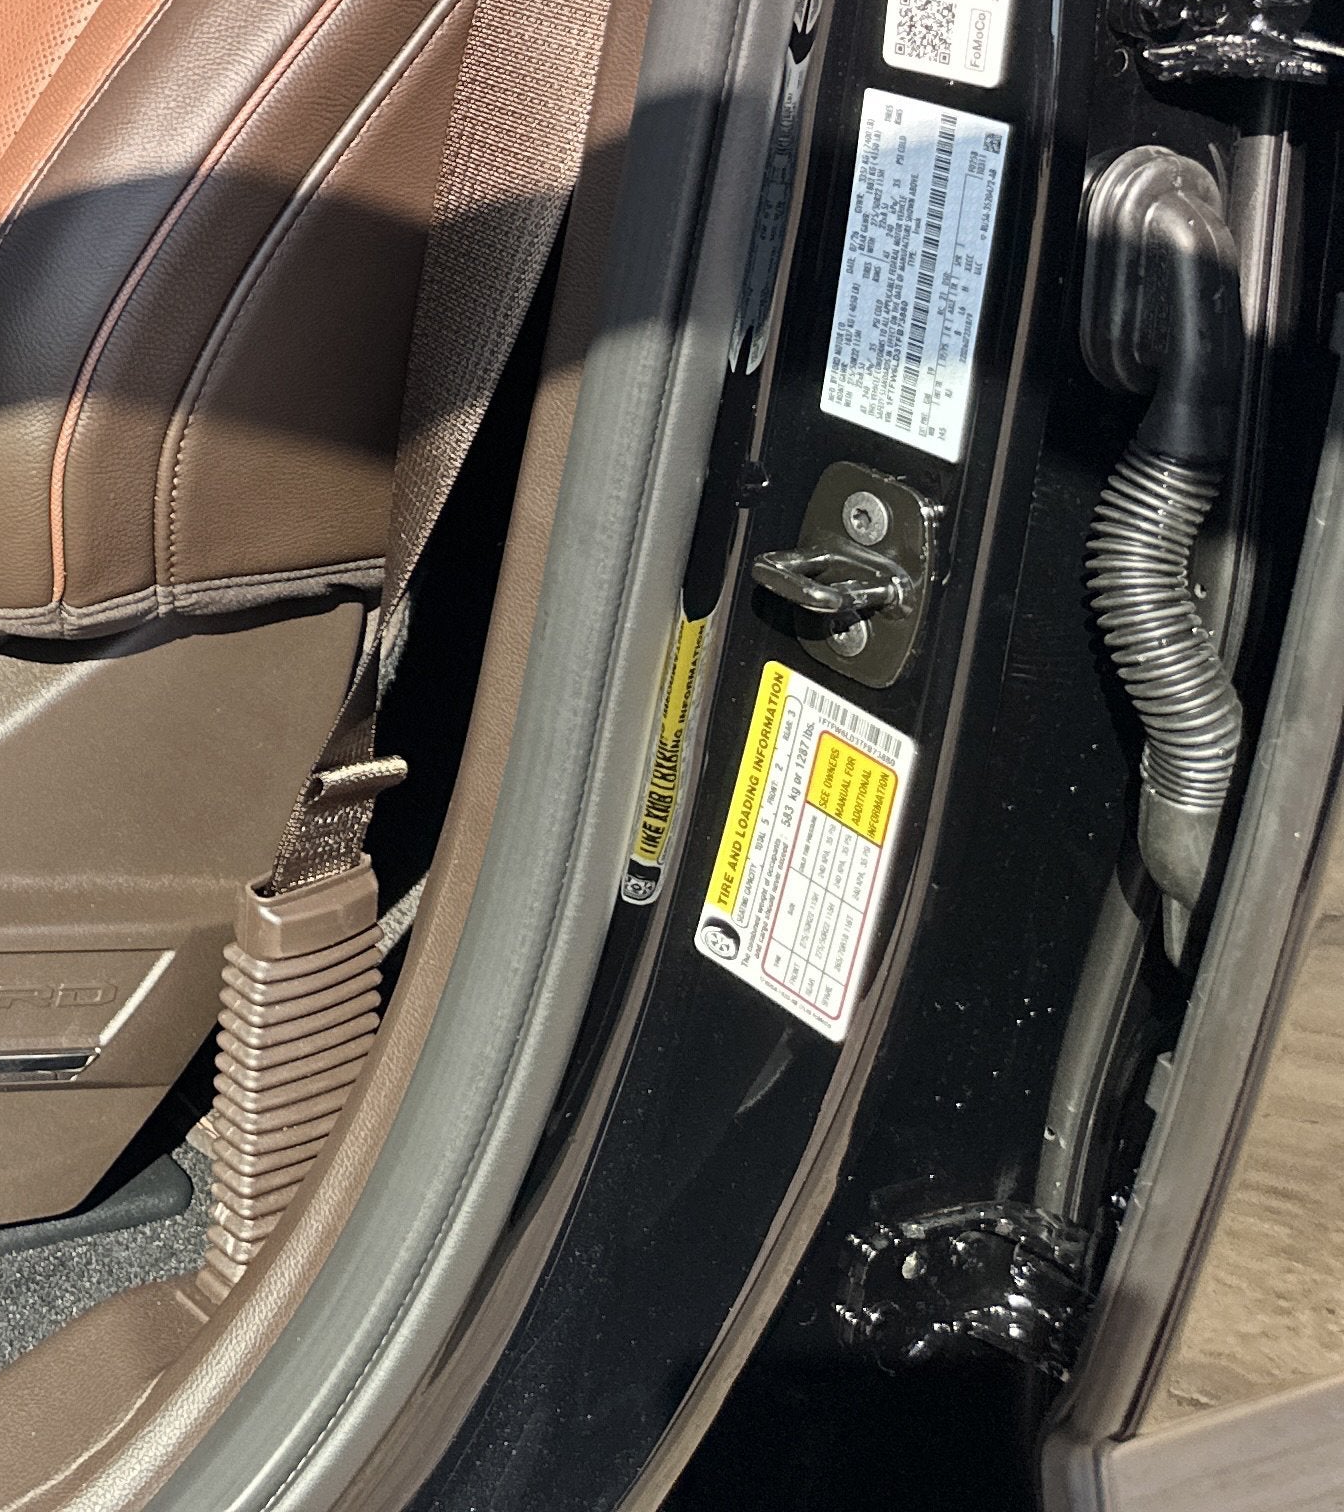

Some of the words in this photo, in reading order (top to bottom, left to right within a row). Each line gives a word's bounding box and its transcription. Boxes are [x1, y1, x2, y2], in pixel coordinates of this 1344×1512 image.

[969, 10, 987, 68] FoMoCo
[896, 134, 907, 154] COLD
[895, 153, 905, 166] PSI
[895, 194, 907, 222] VEHICLE
[904, 196, 915, 223] SHOWN
[891, 221, 903, 247] MOTOR
[896, 223, 911, 272] MANUFACTURE
[887, 247, 899, 276] FEDERAL
[895, 271, 904, 283] OF
[881, 275, 895, 315] APPLICABLE
[892, 282, 903, 300] DATE
[873, 297, 883, 317] COLD
[889, 313, 898, 326] ON
[878, 327, 888, 338] TO
[880, 315, 889, 328] ALL
[873, 337, 886, 375] CONFORMS
[884, 348, 893, 358] IN
[750, 670, 786, 773] INFORMATION
[787, 708, 796, 718] 3
[801, 717, 816, 741] lbs.
[774, 761, 783, 772] 2
[794, 738, 810, 770] 1287
[822, 745, 841, 789] OWNERS
[792, 771, 803, 786] or
[832, 775, 852, 819] MANUAL
[843, 754, 857, 778] FOR
[734, 772, 760, 839] LOADING
[786, 784, 801, 803] kg
[817, 787, 830, 809] SEE
[849, 766, 873, 826] ADDITIONAL
[865, 770, 890, 839] INFORMATION
[760, 815, 770, 826] 5
[780, 802, 795, 828] 583
[726, 838, 743, 872] AND
[765, 835, 782, 879] occupants
[775, 840, 789, 871] exceed
[717, 871, 734, 908] TIRE
[735, 894, 749, 924] SEATING
[742, 861, 758, 897] CAPACITY
[762, 876, 770, 887] of
[770, 870, 781, 894] never
[754, 885, 769, 915] weight
[762, 892, 775, 920] should
[745, 913, 761, 953] combined
[757, 919, 770, 945] cargo
[740, 950, 751, 969] The
[752, 941, 763, 960] and
